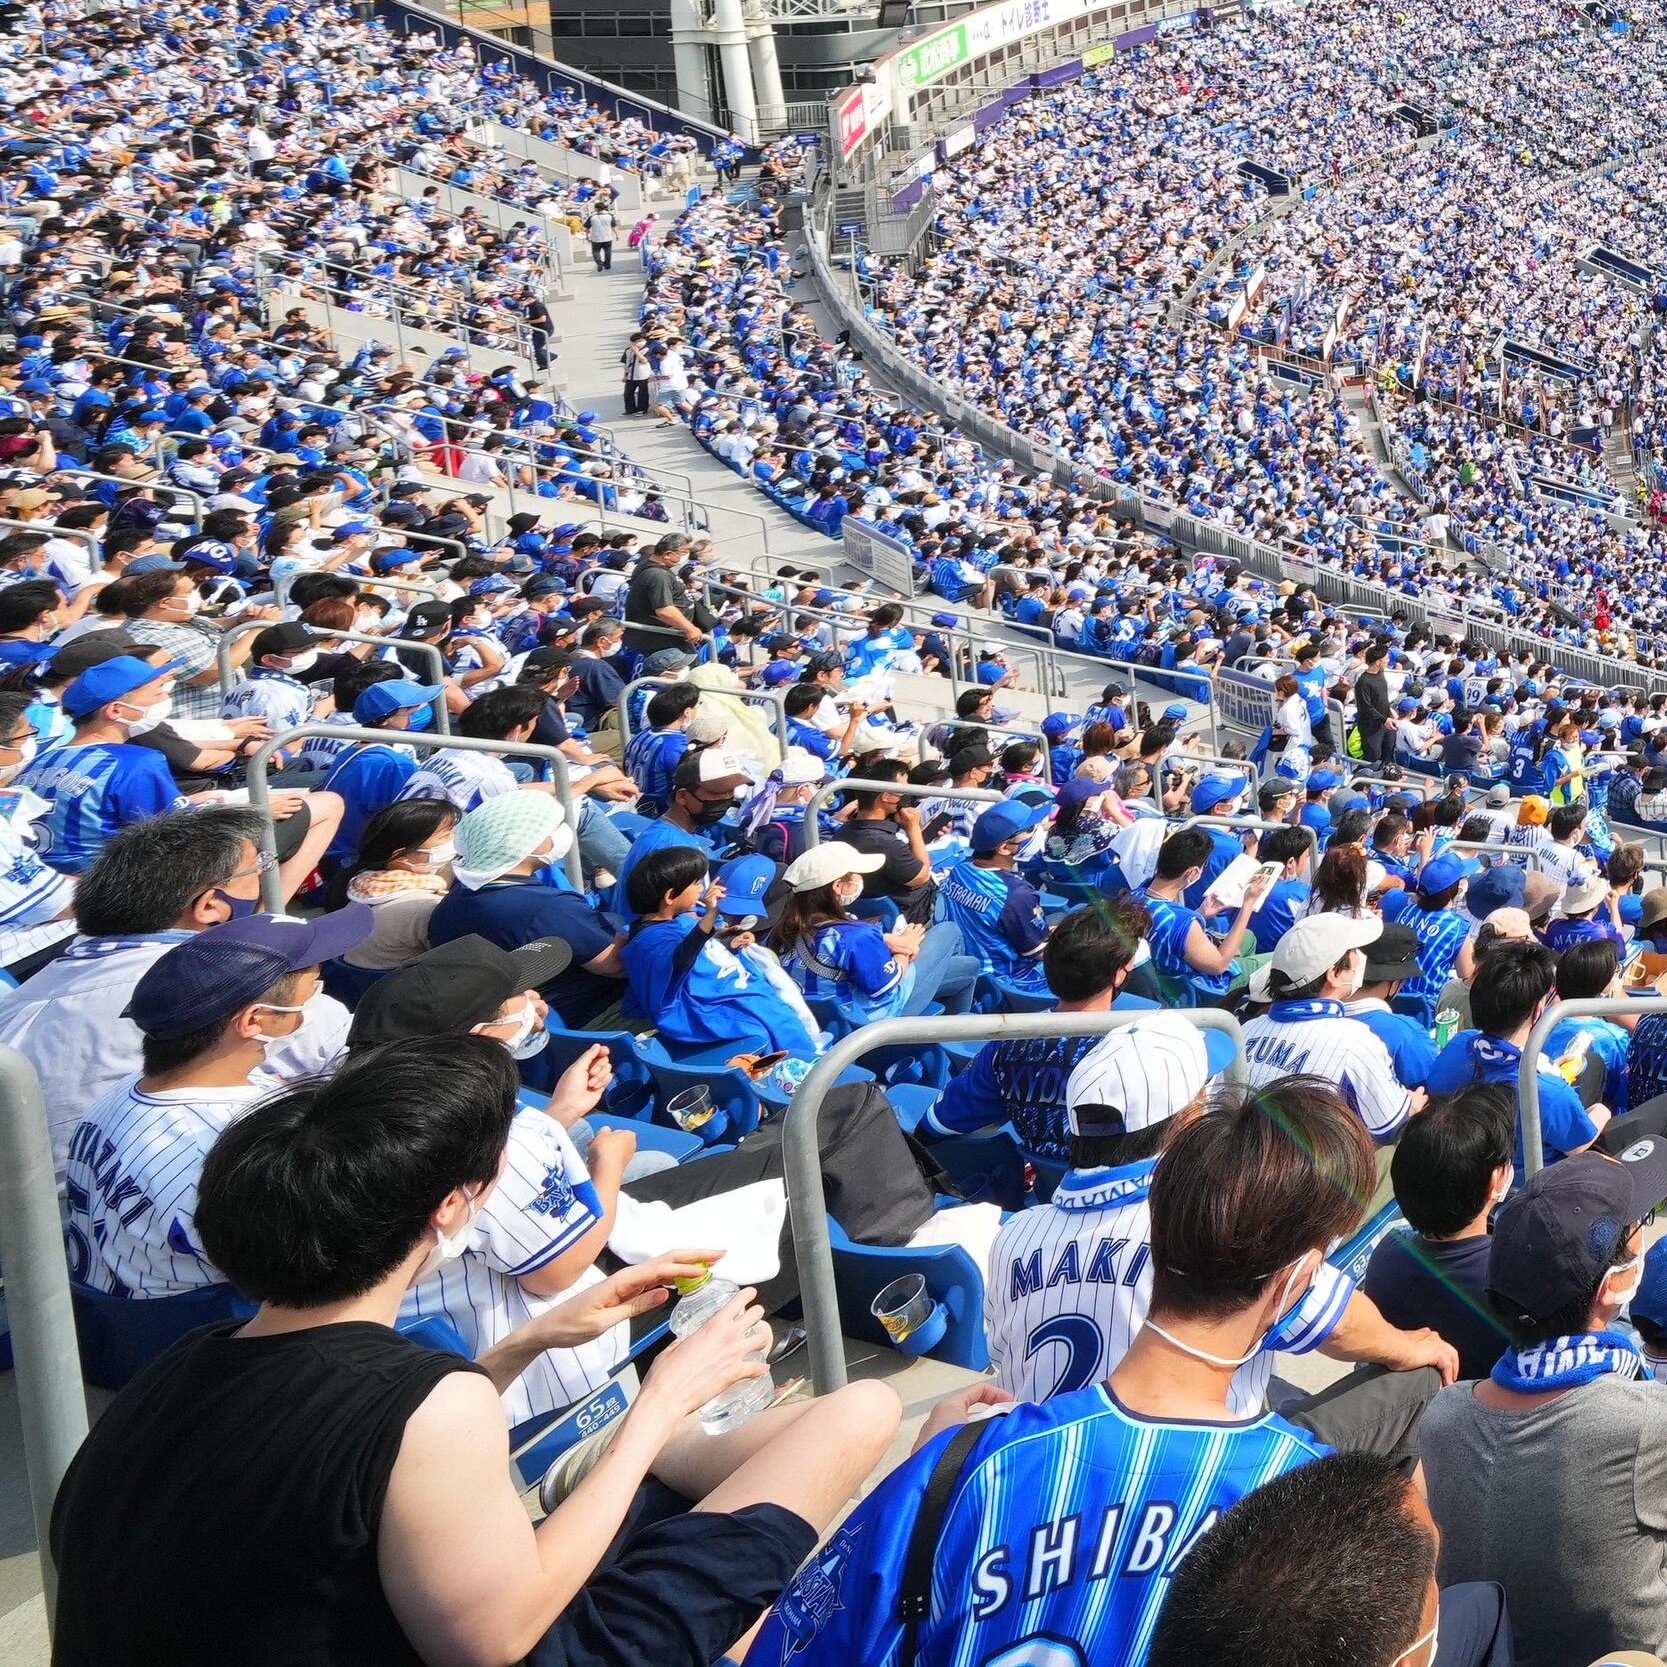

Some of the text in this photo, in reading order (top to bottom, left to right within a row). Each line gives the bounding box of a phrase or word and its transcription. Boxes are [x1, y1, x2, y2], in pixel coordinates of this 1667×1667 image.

[301, 737, 345, 756] HIBAT
[1513, 759, 1525, 779] 3
[1401, 916, 1441, 938] SANO
[1244, 1035, 1312, 1074] ZUMA
[67, 1120, 154, 1230] IYAZAKI
[1009, 1236, 1149, 1302] MAKI
[576, 1395, 618, 1430] 65段
[580, 1404, 621, 1439] 440-449
